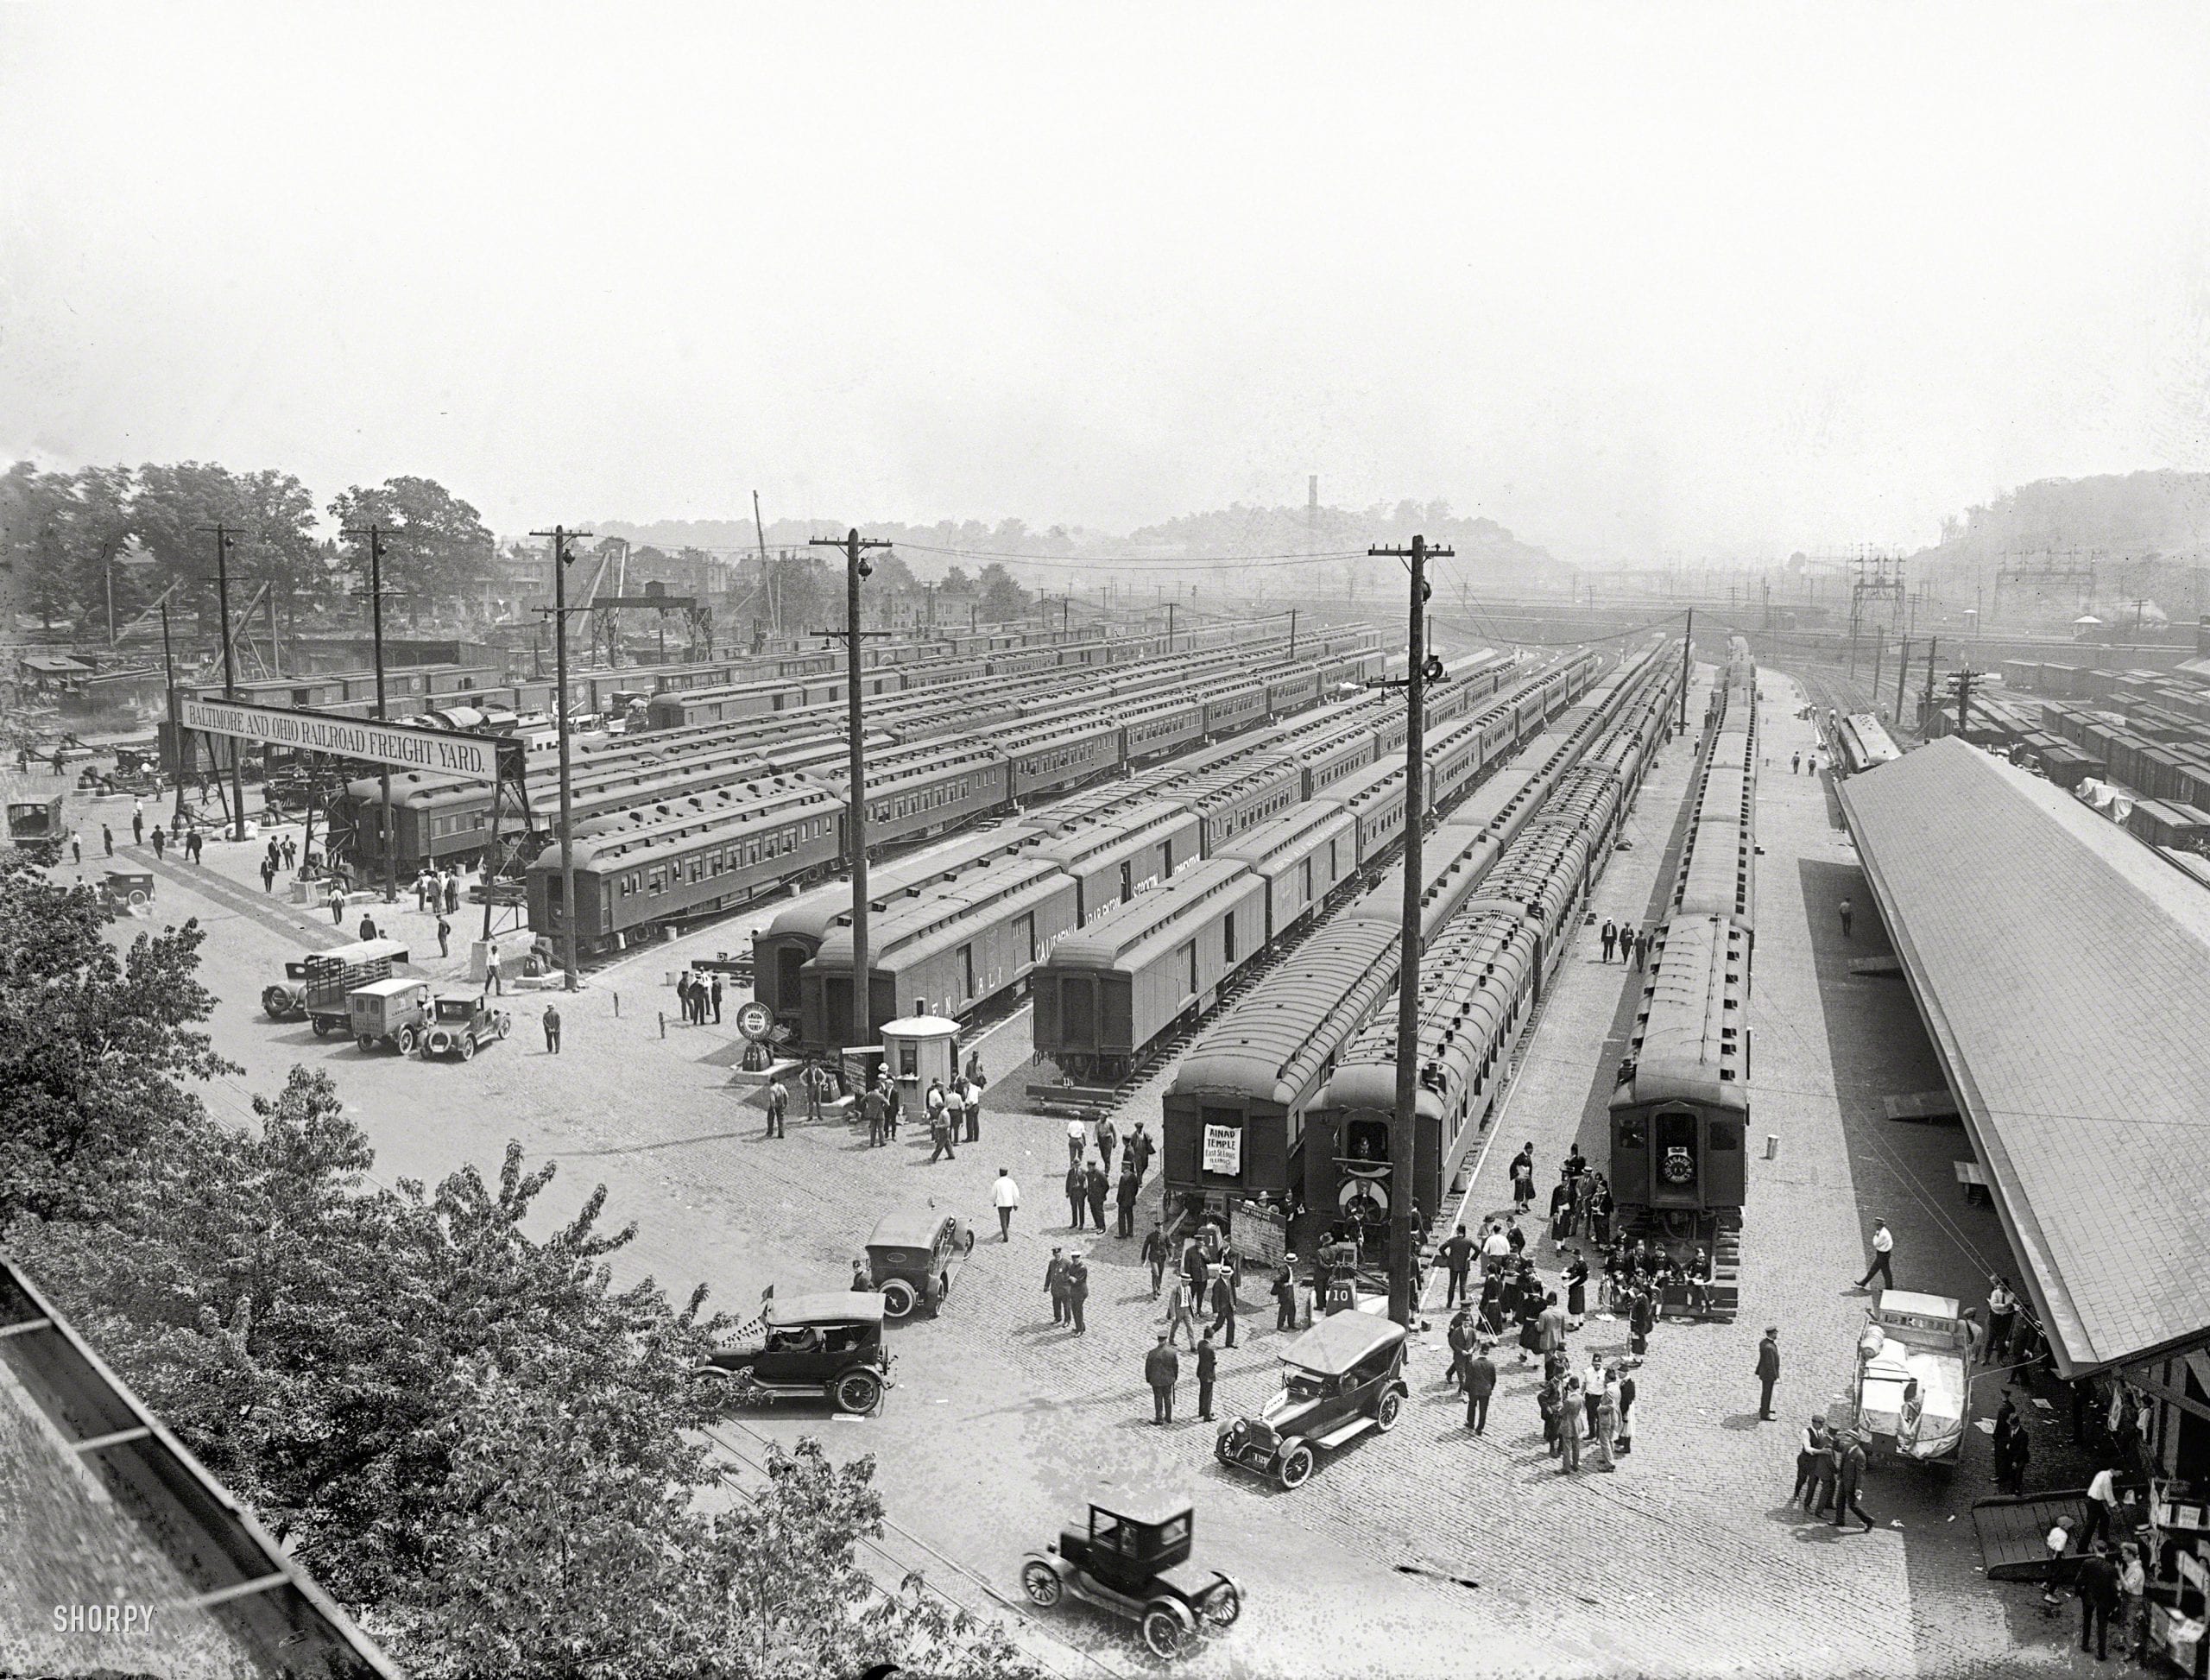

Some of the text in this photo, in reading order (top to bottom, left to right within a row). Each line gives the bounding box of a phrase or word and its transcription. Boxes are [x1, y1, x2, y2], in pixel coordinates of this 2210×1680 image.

[188, 704, 485, 774] BALTIMORE AND OHIO RAILROAD FREIGHT YARD.
[1209, 1128, 1235, 1139] AINAD
[1208, 1139, 1235, 1150] TEMPLE
[1333, 1289, 1348, 1302] 10
